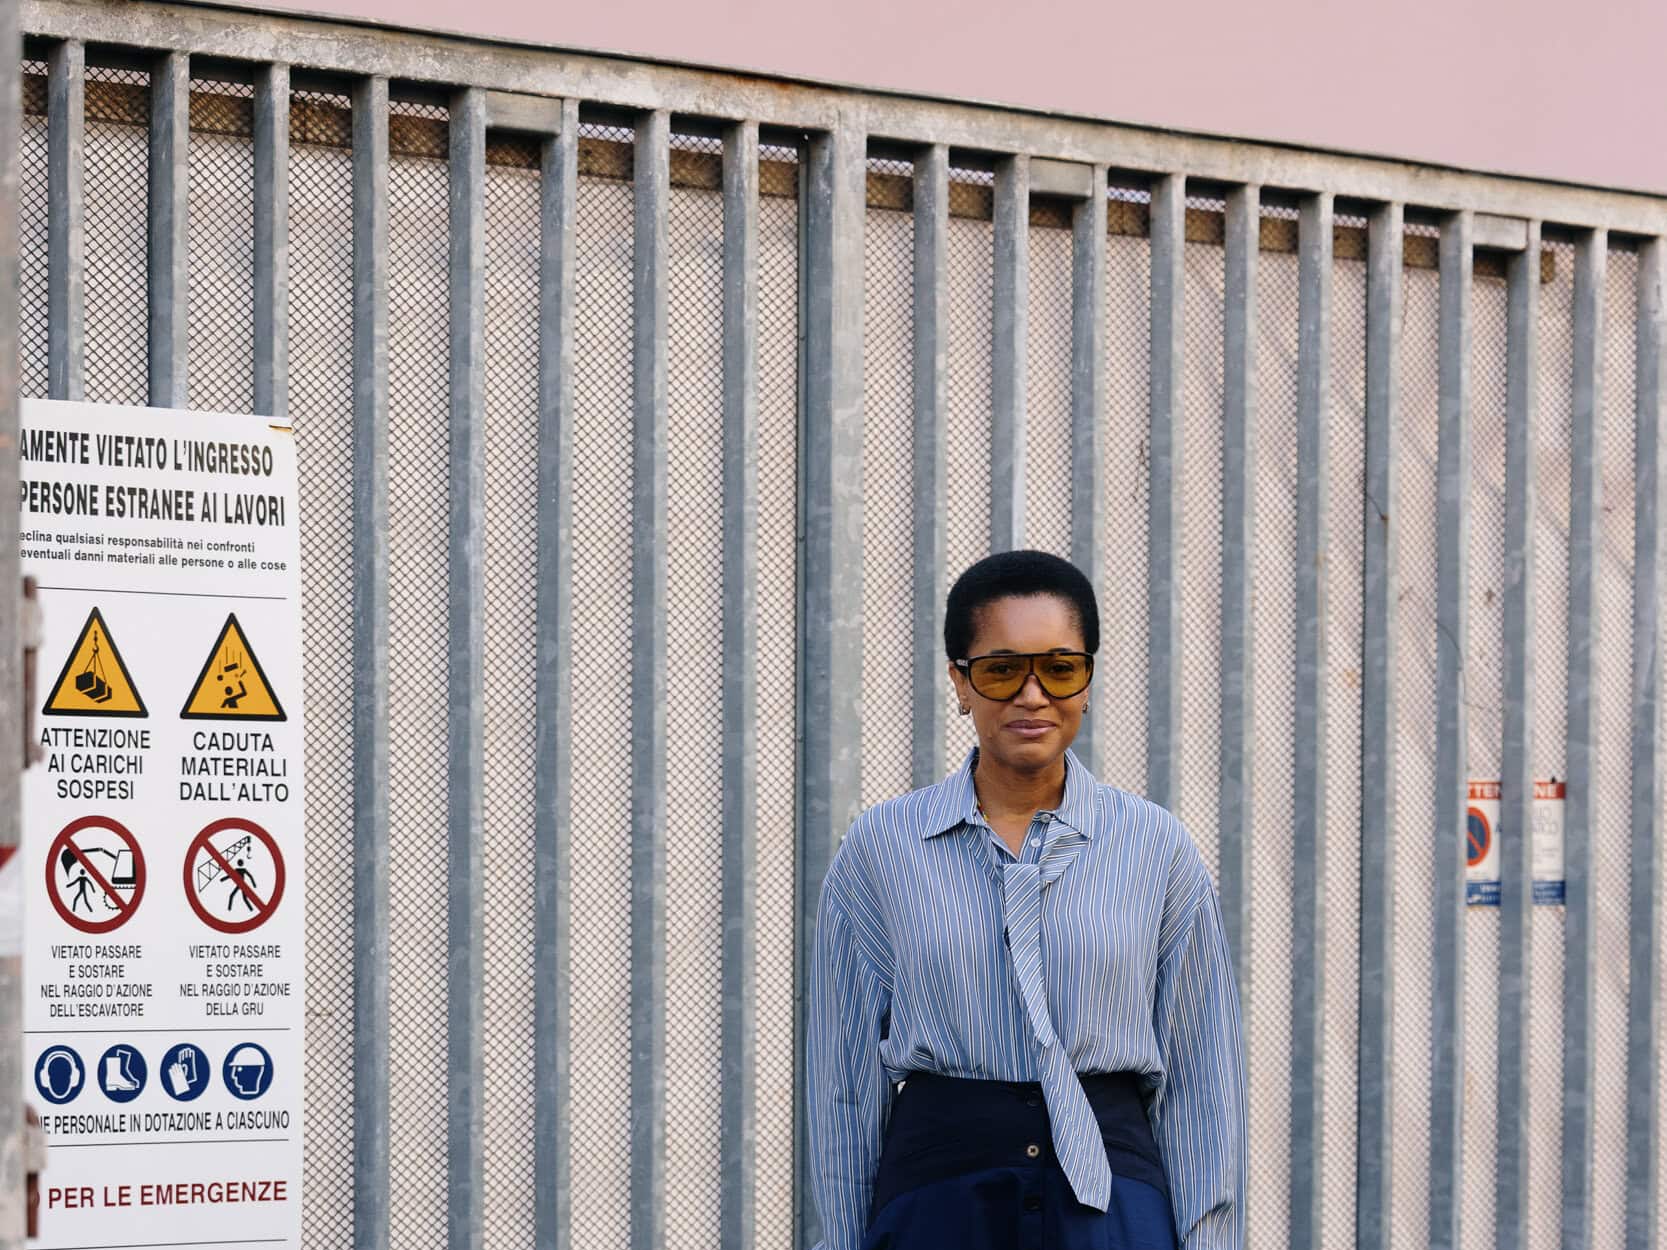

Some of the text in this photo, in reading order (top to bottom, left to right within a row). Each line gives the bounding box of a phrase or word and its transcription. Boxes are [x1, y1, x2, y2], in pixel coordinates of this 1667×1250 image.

[97, 434, 167, 470] VIETATO
[174, 440, 272, 476] L'INGRESSO
[106, 486, 194, 521] ESTRANEE
[201, 492, 216, 522] AI
[225, 493, 284, 526] LAVORI
[56, 533, 104, 546] qualsiasi
[108, 537, 183, 551] responsabilità
[187, 540, 202, 549] nei
[207, 541, 254, 552] confronti
[21, 548, 71, 560] eventuali
[75, 550, 103, 561] danni
[108, 553, 154, 564] materiali
[159, 555, 177, 565] alle
[182, 558, 223, 568] persone
[238, 559, 256, 569] alle
[261, 562, 285, 570] cose
[41, 728, 150, 749] ATTENZIONE
[194, 732, 274, 752] CADUTA
[48, 754, 142, 774] AI CARICHI
[182, 757, 286, 776] MATERIALI
[57, 779, 133, 799] SOSPESI
[180, 782, 288, 802] DALL'ALTO
[52, 945, 141, 959] VIETATO PASSARE
[190, 945, 280, 958] VIETATO PASSARE
[69, 965, 124, 978] E SOSTARE
[207, 964, 262, 977] E SOSTARE
[41, 984, 152, 998] NEL RAGGIO D'AZIONE
[180, 983, 290, 996] NEL RAGGIO D'AZIONE
[50, 1003, 143, 1017] DELL'ESCAVATORE
[206, 1002, 263, 1015] DELLA GRU
[55, 1114, 126, 1134] PERSONALE
[130, 1114, 140, 1132] IN
[145, 1112, 211, 1132] DOTAZIONE
[216, 1112, 223, 1130] A
[227, 1110, 289, 1130] CIASCUNO
[49, 1181, 287, 1209] PER LE EMERGENZE
